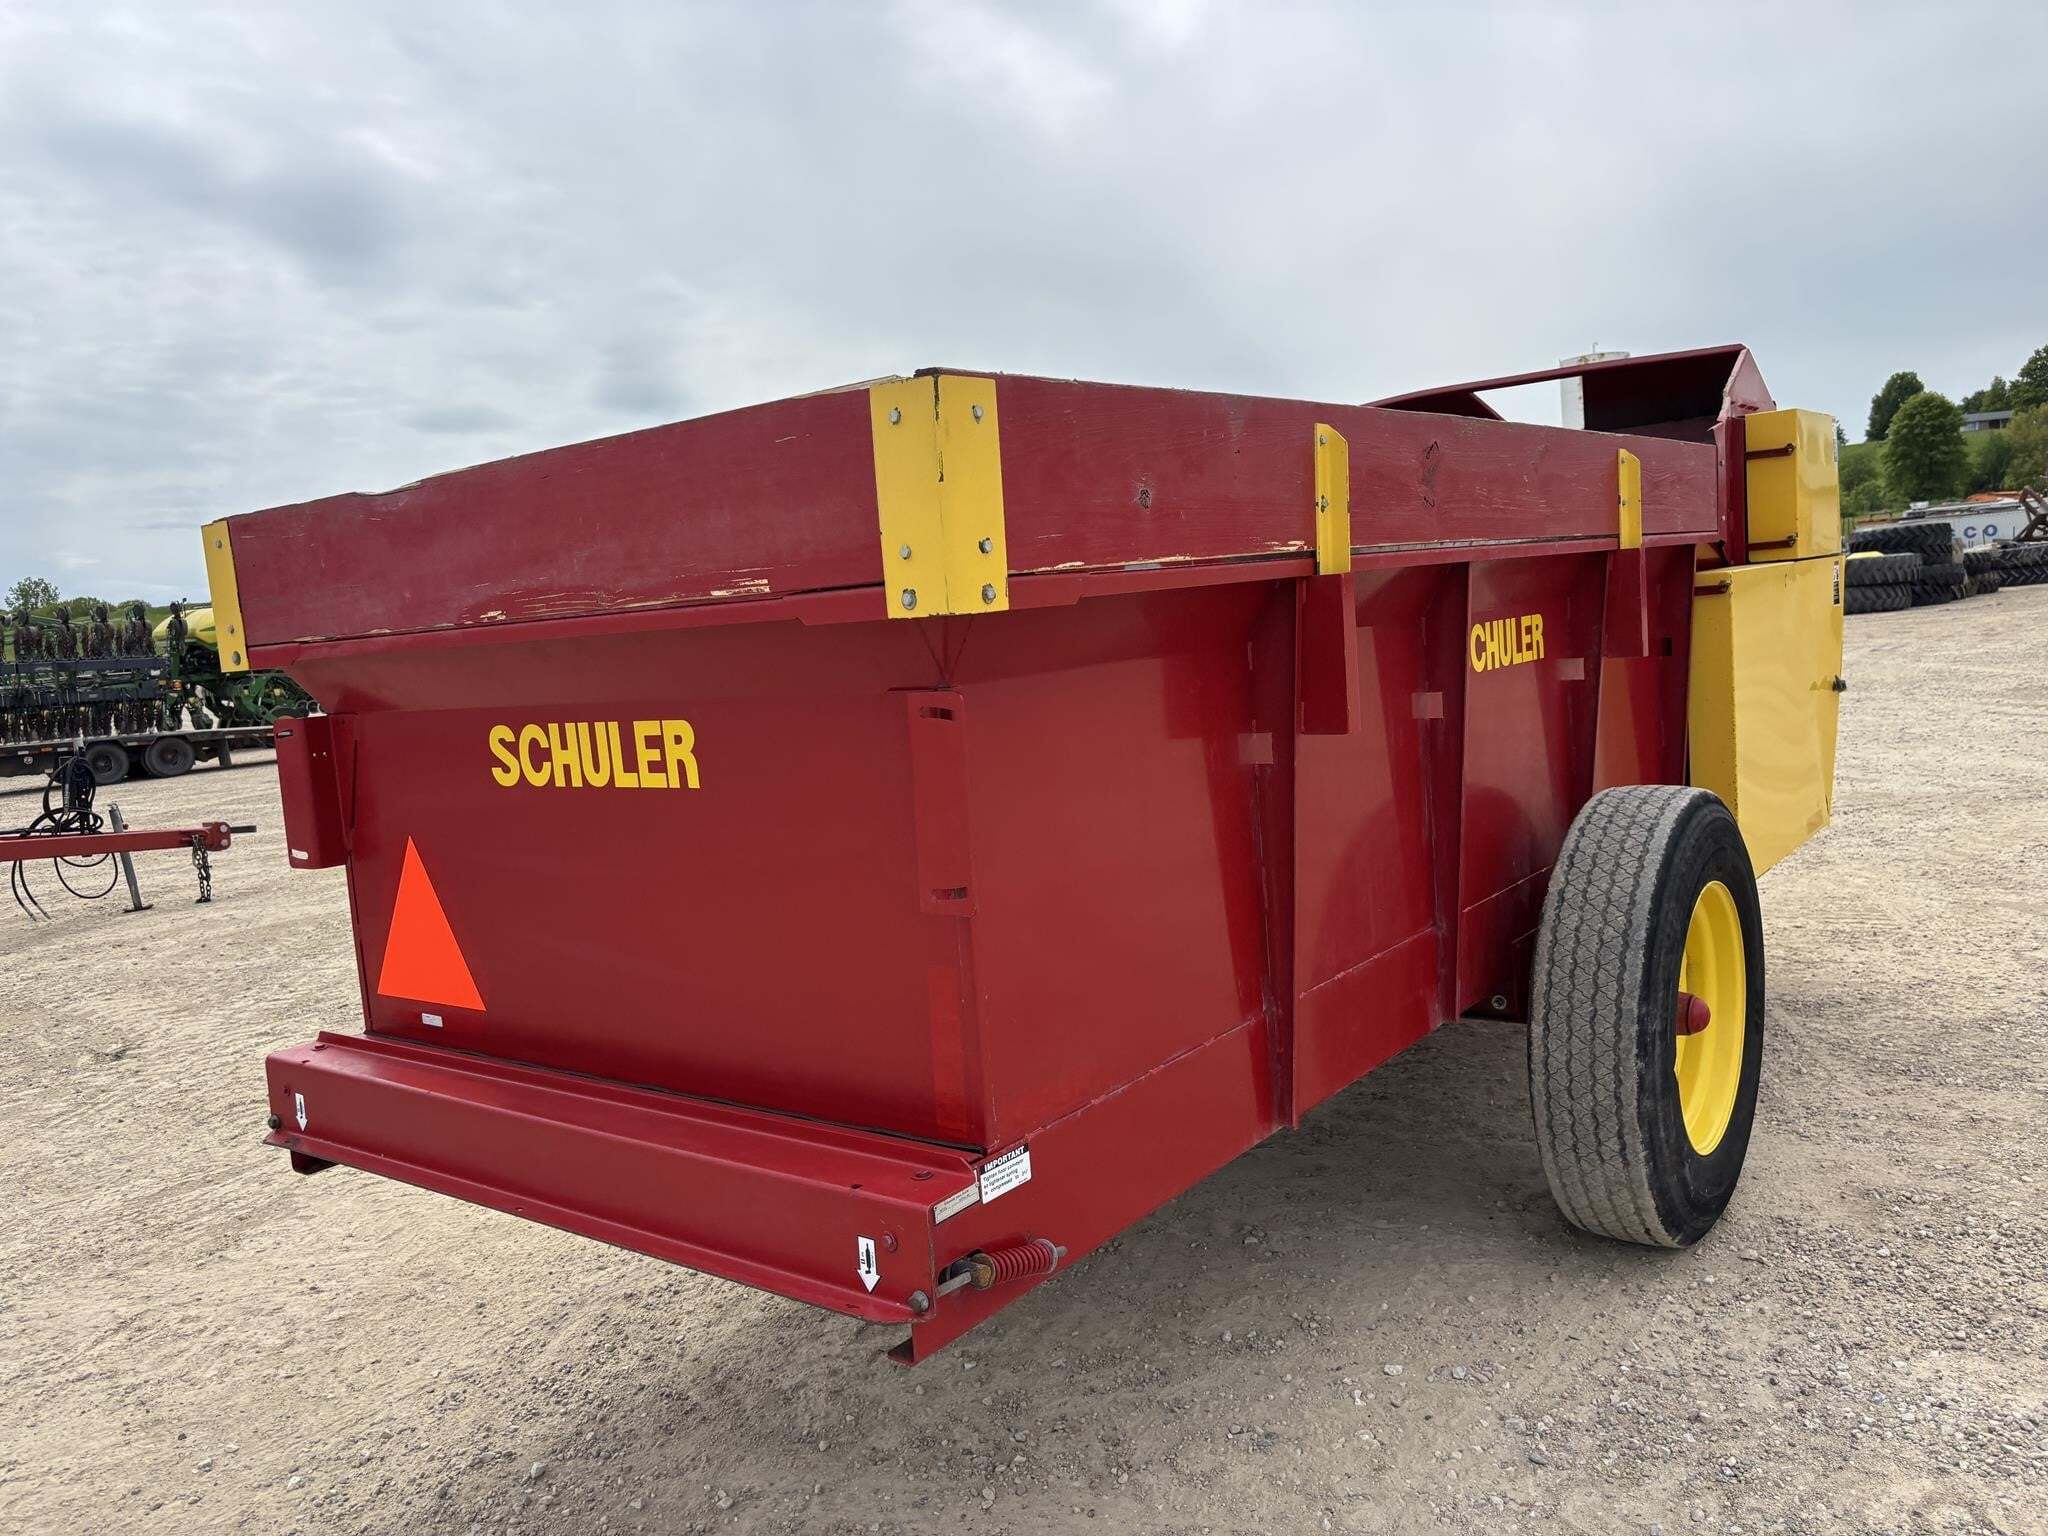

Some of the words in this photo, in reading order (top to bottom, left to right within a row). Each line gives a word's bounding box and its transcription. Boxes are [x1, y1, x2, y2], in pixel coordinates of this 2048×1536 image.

[1470, 613, 1544, 672] CHULER
[488, 719, 701, 789] SCHULER
[984, 1145, 1025, 1172] IMPORTANT
